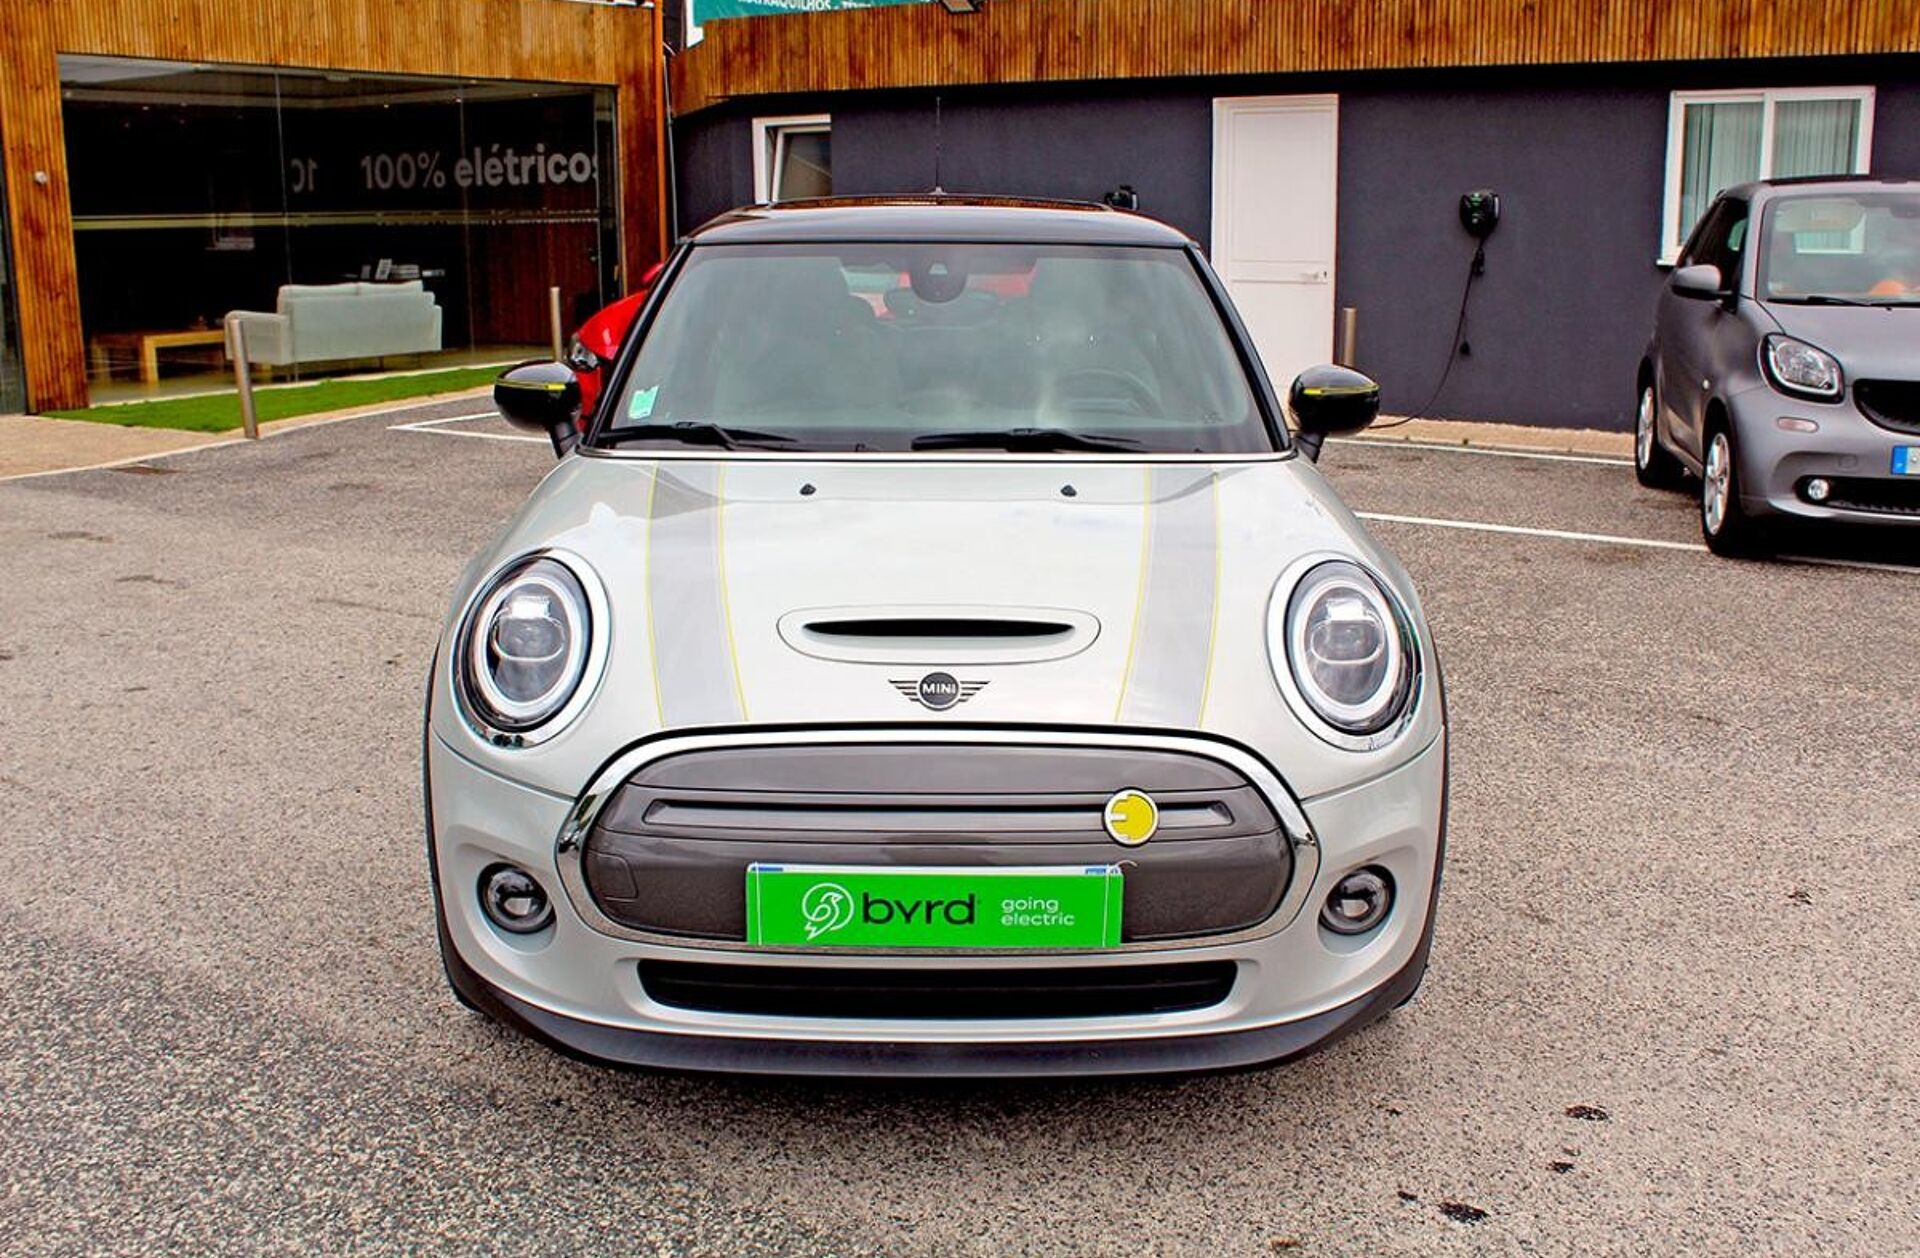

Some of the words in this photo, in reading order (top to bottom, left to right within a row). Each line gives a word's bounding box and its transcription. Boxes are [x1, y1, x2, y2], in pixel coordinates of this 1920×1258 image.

[360, 151, 446, 190] 100%
[922, 683, 956, 695] MINI
[1001, 896, 1059, 914] going
[1000, 912, 1076, 926] electric
